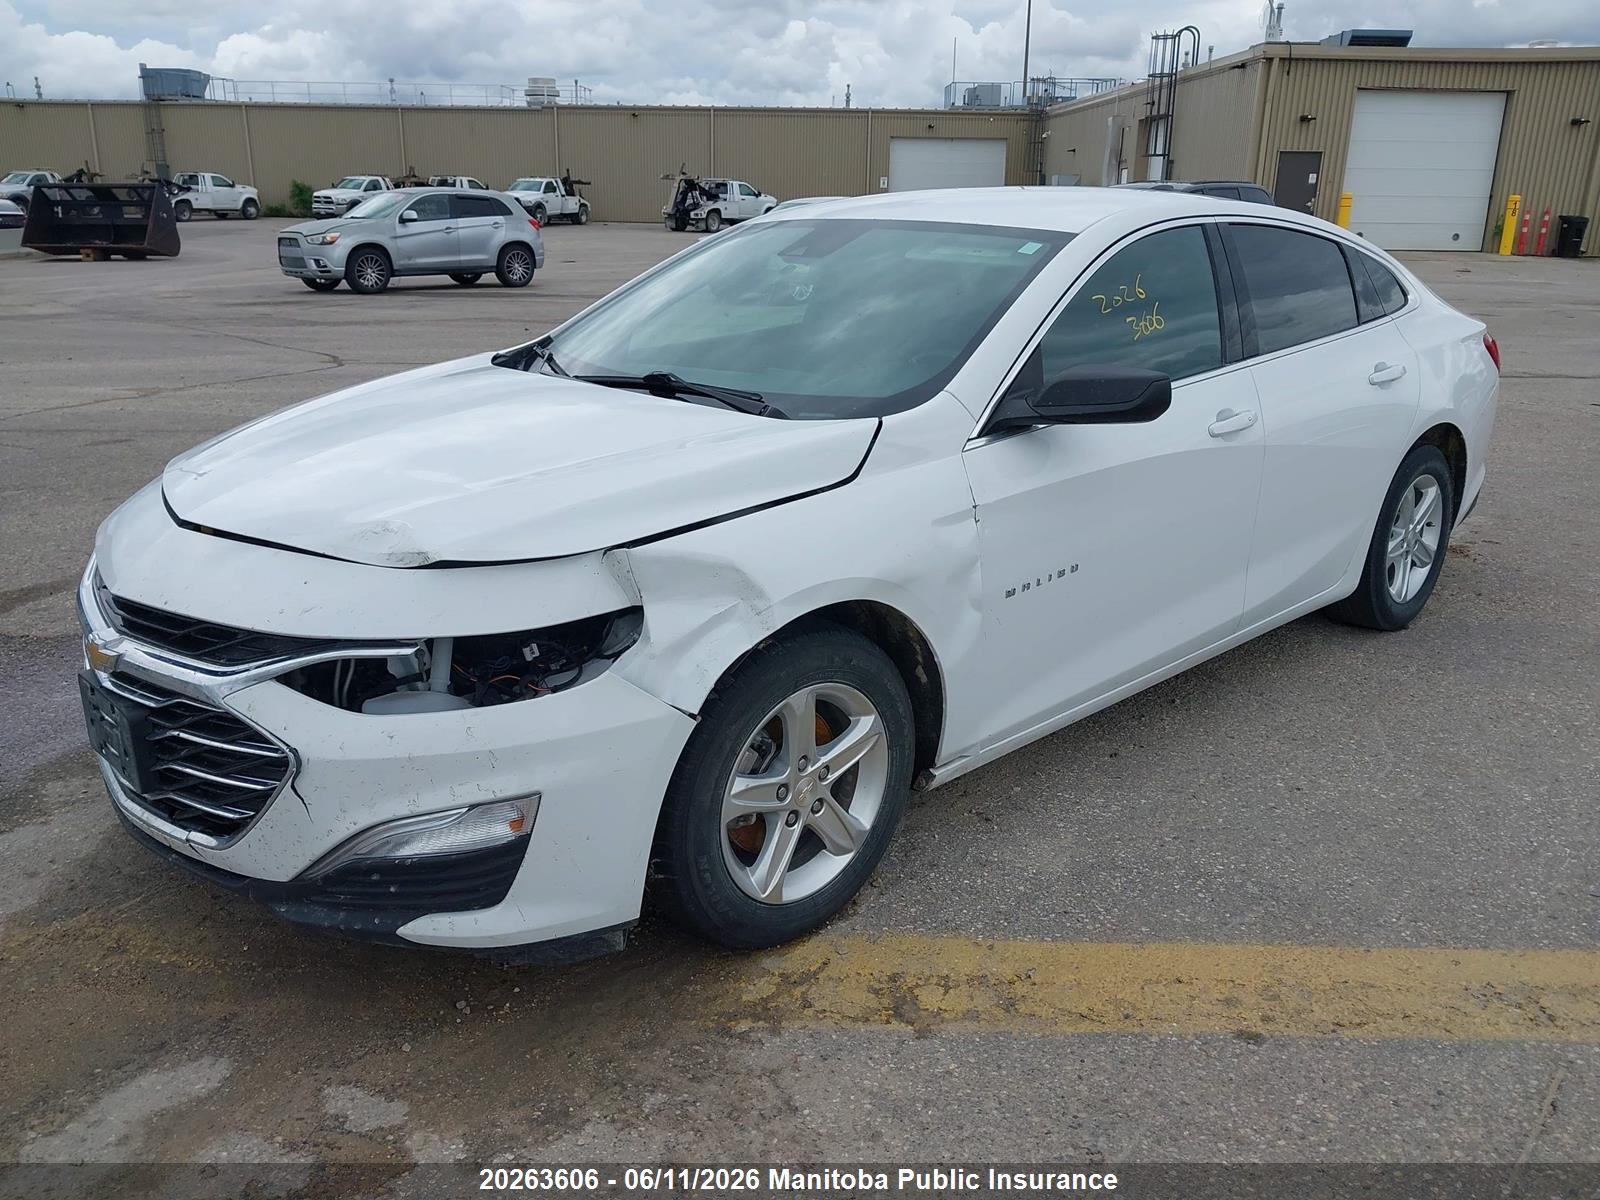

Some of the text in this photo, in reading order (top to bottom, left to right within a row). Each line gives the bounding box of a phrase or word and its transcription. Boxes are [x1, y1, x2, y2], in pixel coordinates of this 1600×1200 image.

[1091, 273, 1146, 314] 2026
[1126, 301, 1165, 340] 3606
[1004, 563, 1080, 599] MALIBU
